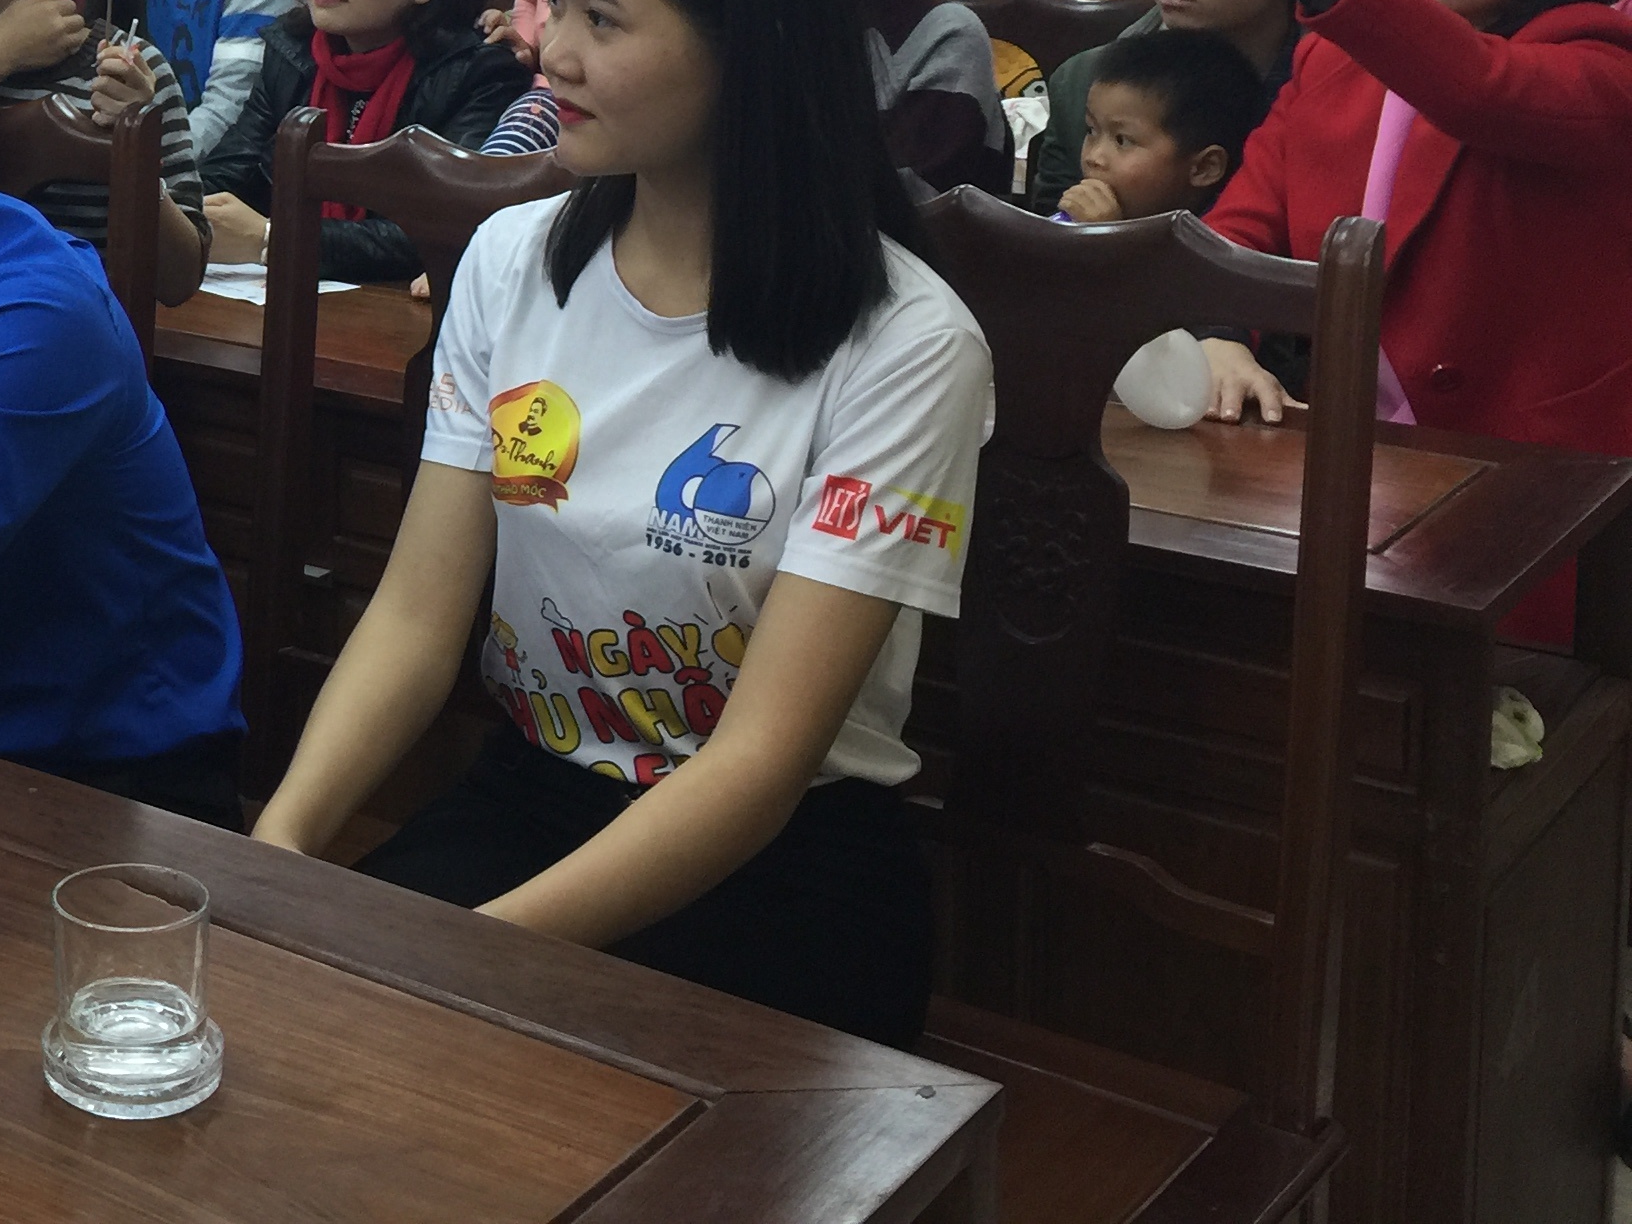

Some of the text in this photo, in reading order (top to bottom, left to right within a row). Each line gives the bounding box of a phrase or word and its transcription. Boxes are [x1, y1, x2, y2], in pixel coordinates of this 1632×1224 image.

[818, 483, 867, 531] LET'S
[645, 532, 683, 557] 1956
[702, 550, 750, 569] 2016
[552, 609, 701, 678] NGÀY
[493, 669, 581, 755] HỦ
